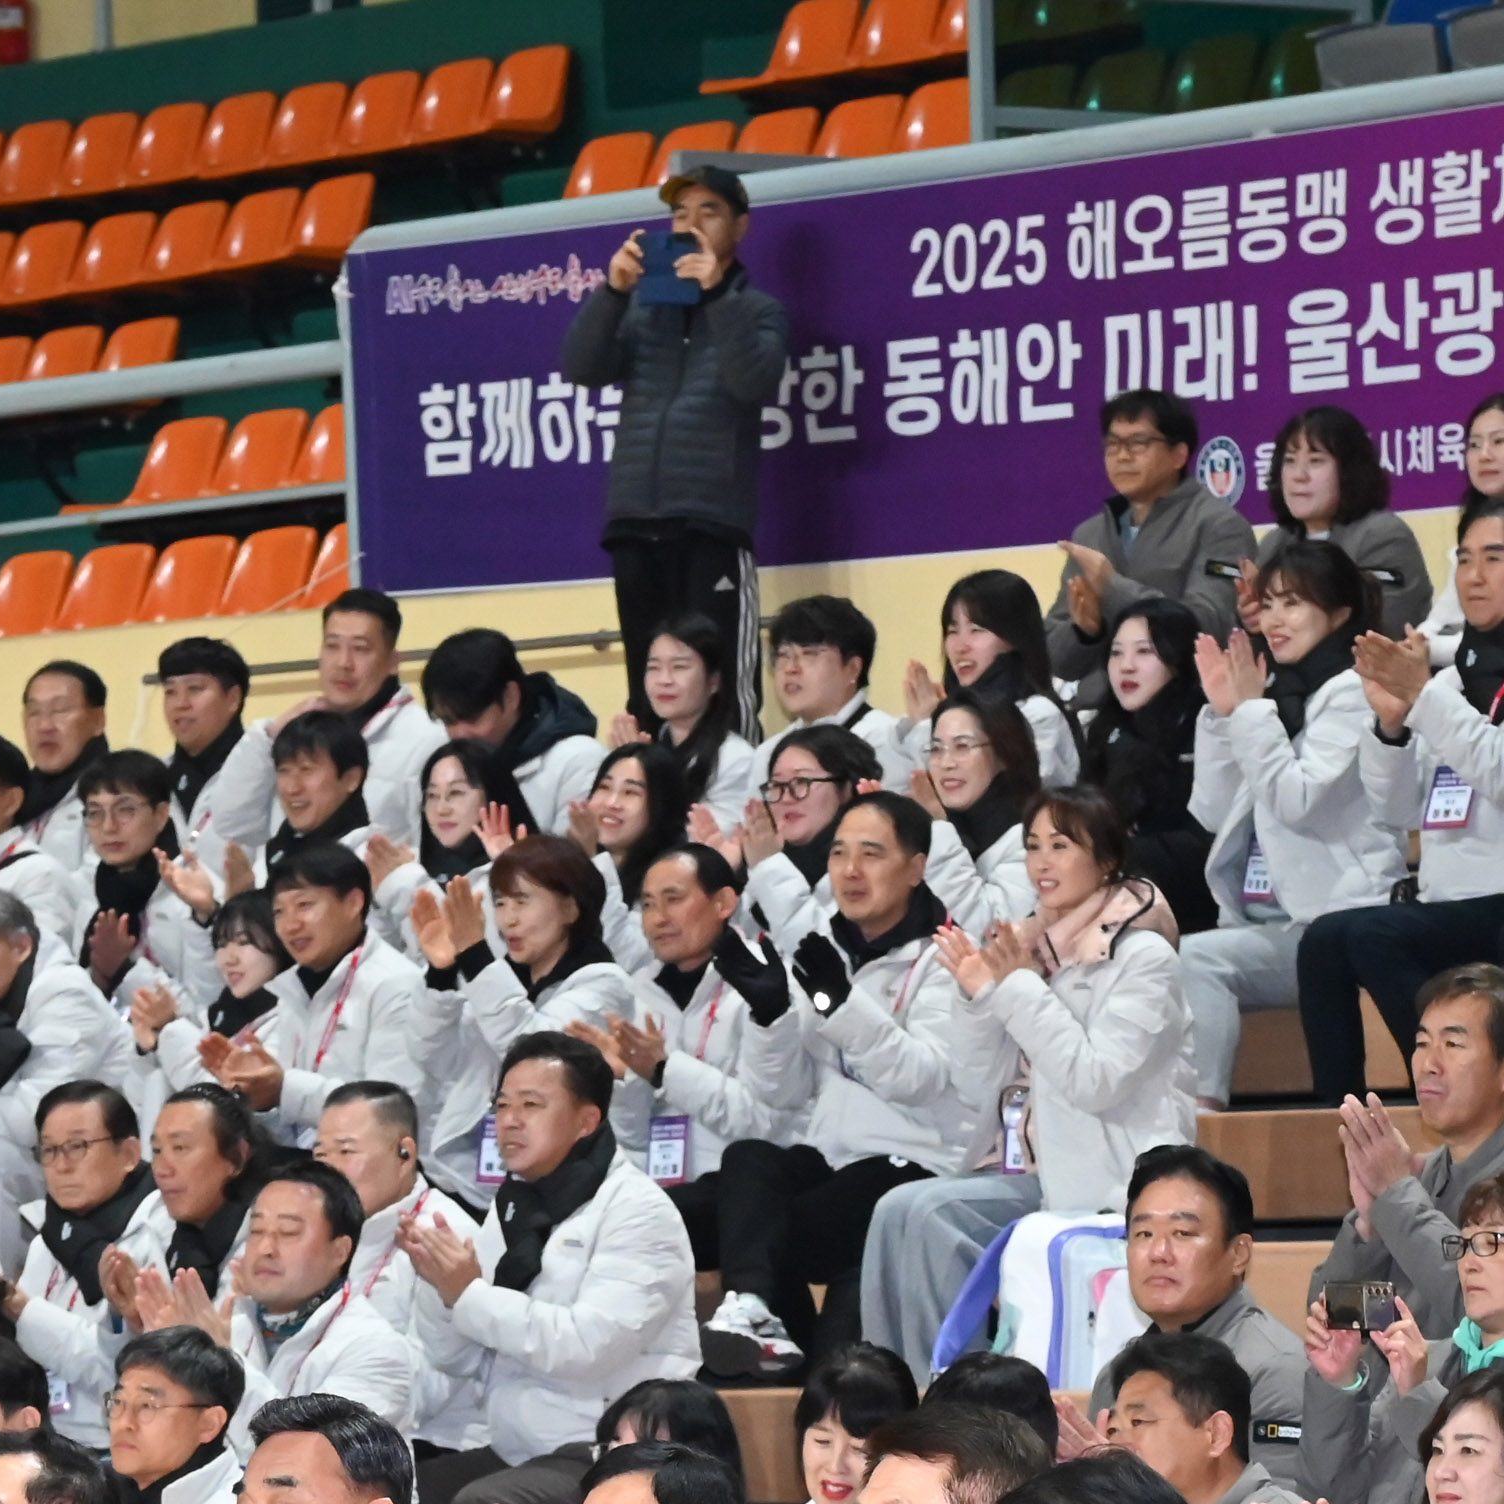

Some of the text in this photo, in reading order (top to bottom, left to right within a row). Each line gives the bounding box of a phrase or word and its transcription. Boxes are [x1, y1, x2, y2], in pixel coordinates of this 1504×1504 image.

[911, 215, 1049, 298] 2025
[1066, 169, 1348, 281] 해오름동맹
[883, 321, 1083, 437] 동해안
[1104, 301, 1259, 402] 미래!
